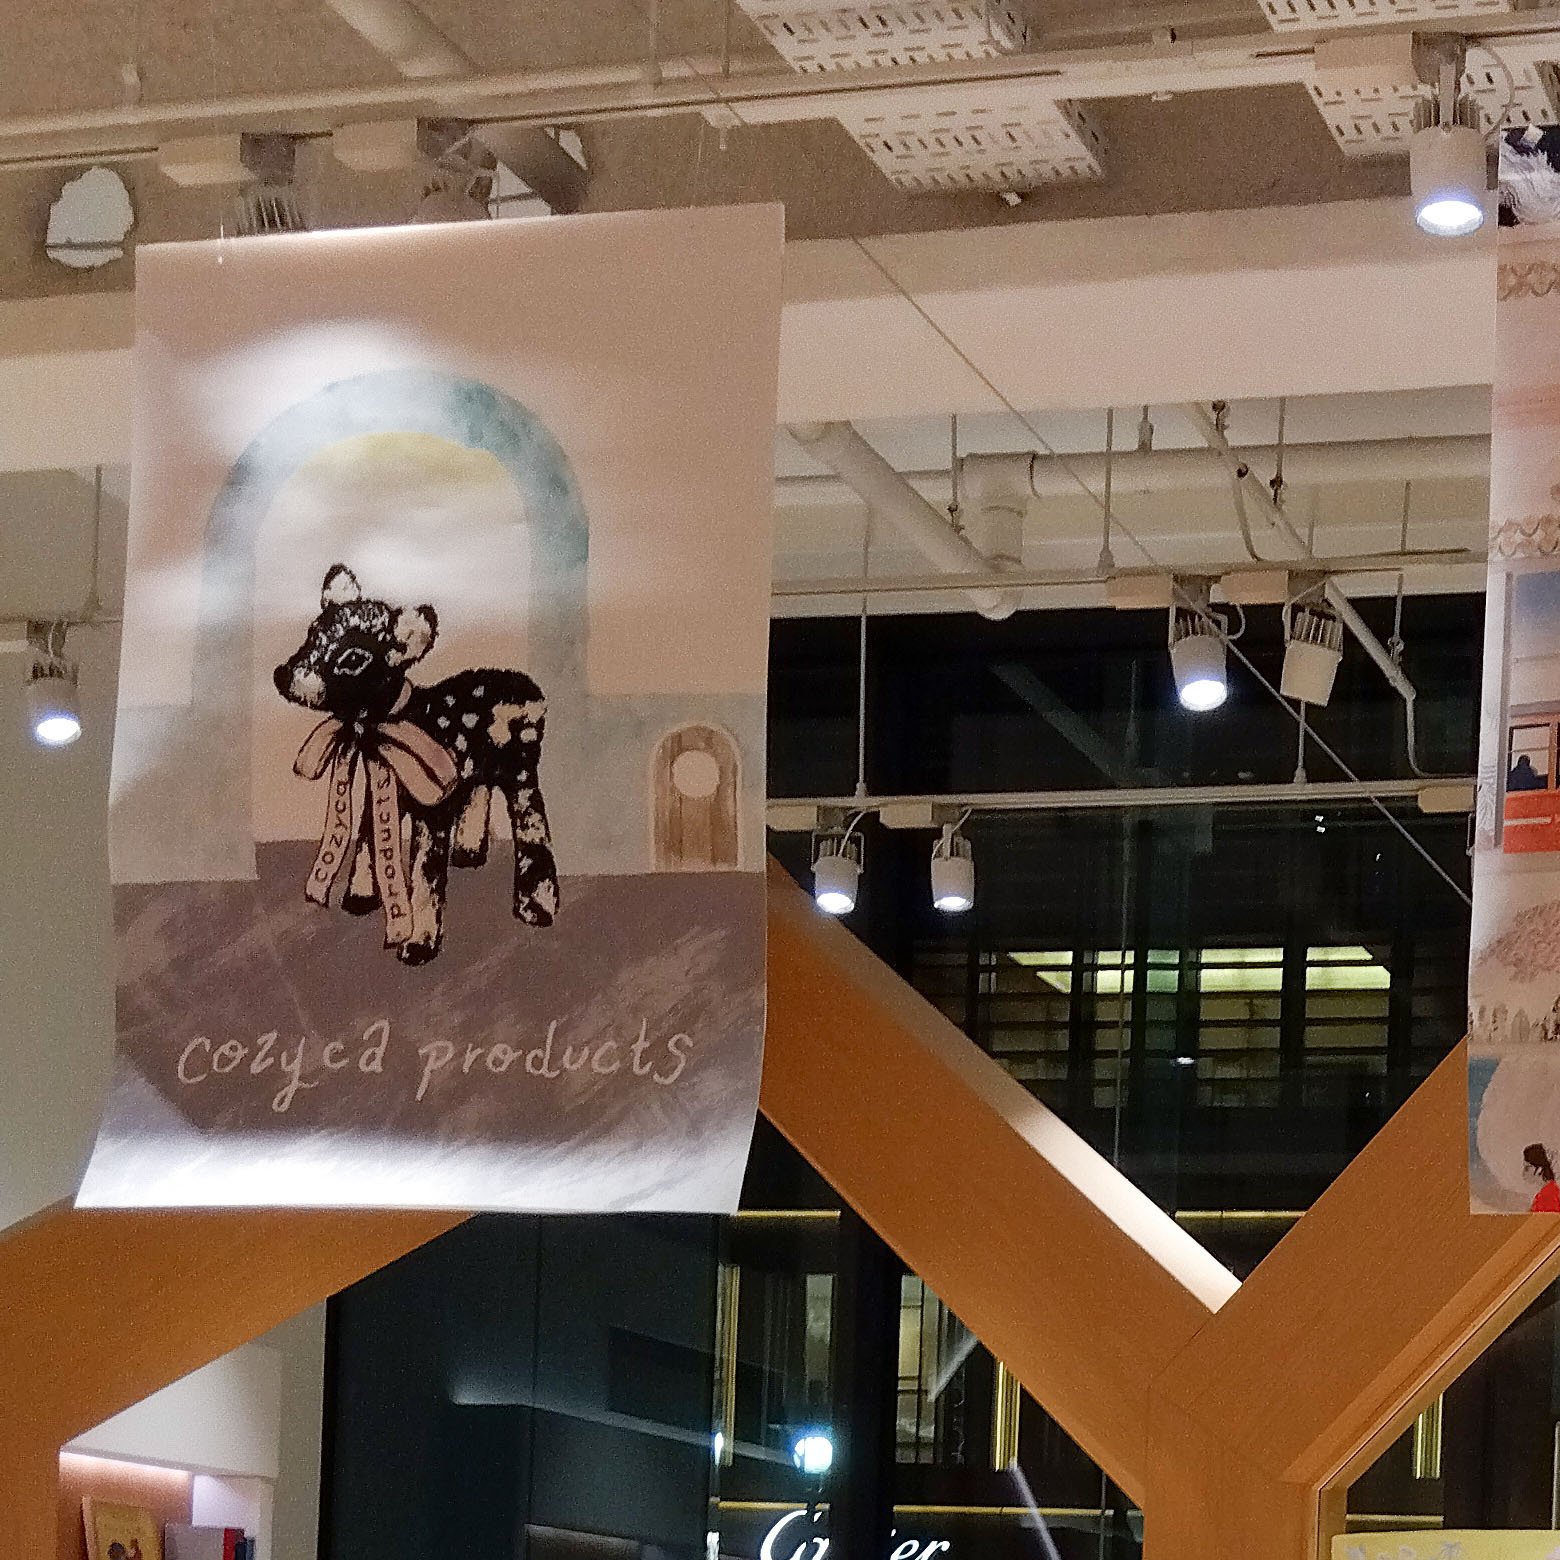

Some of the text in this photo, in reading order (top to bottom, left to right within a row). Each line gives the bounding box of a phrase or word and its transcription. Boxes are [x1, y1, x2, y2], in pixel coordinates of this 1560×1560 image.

[314, 768, 402, 921] cozyca products
[177, 1018, 695, 1113] cozyca products
